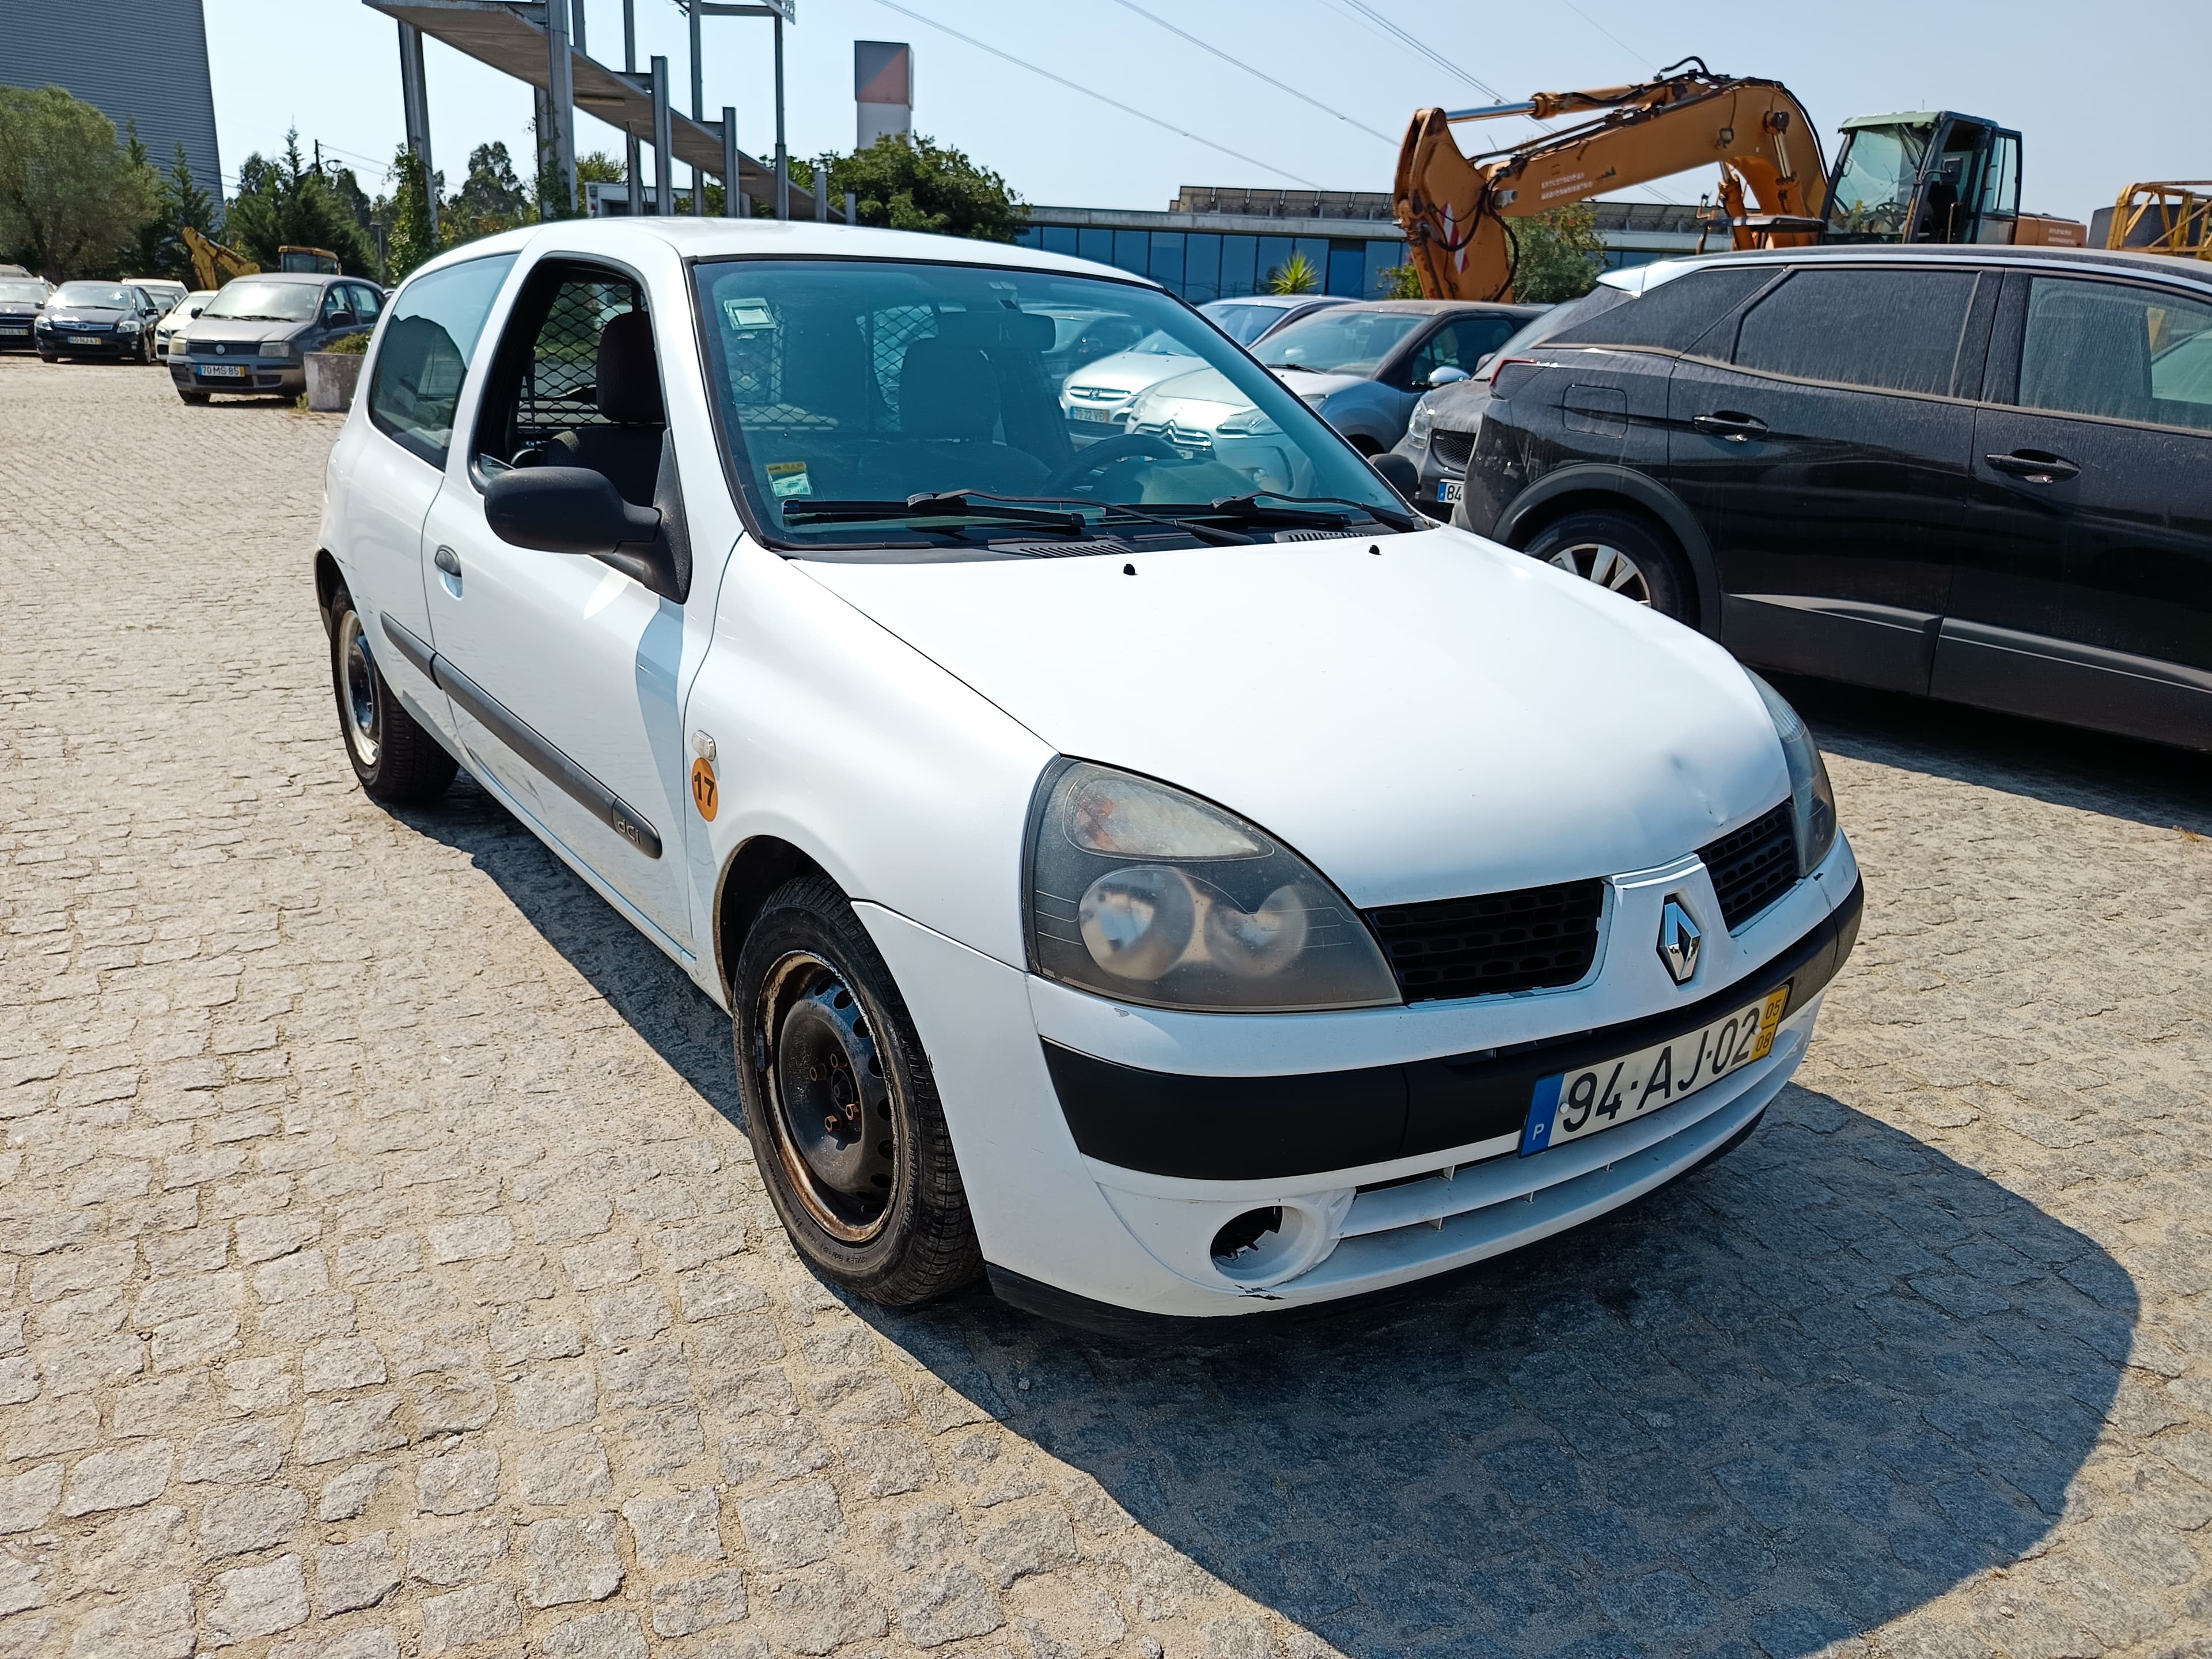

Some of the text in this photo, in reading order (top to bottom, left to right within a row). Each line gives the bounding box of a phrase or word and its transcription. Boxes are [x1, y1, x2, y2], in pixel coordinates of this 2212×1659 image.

[1447, 485, 1461, 501] 84
[694, 771, 715, 807] 17
[1765, 998, 1782, 1020] 05
[1755, 1032, 1771, 1052] 08
[1532, 1123, 1545, 1141] P
